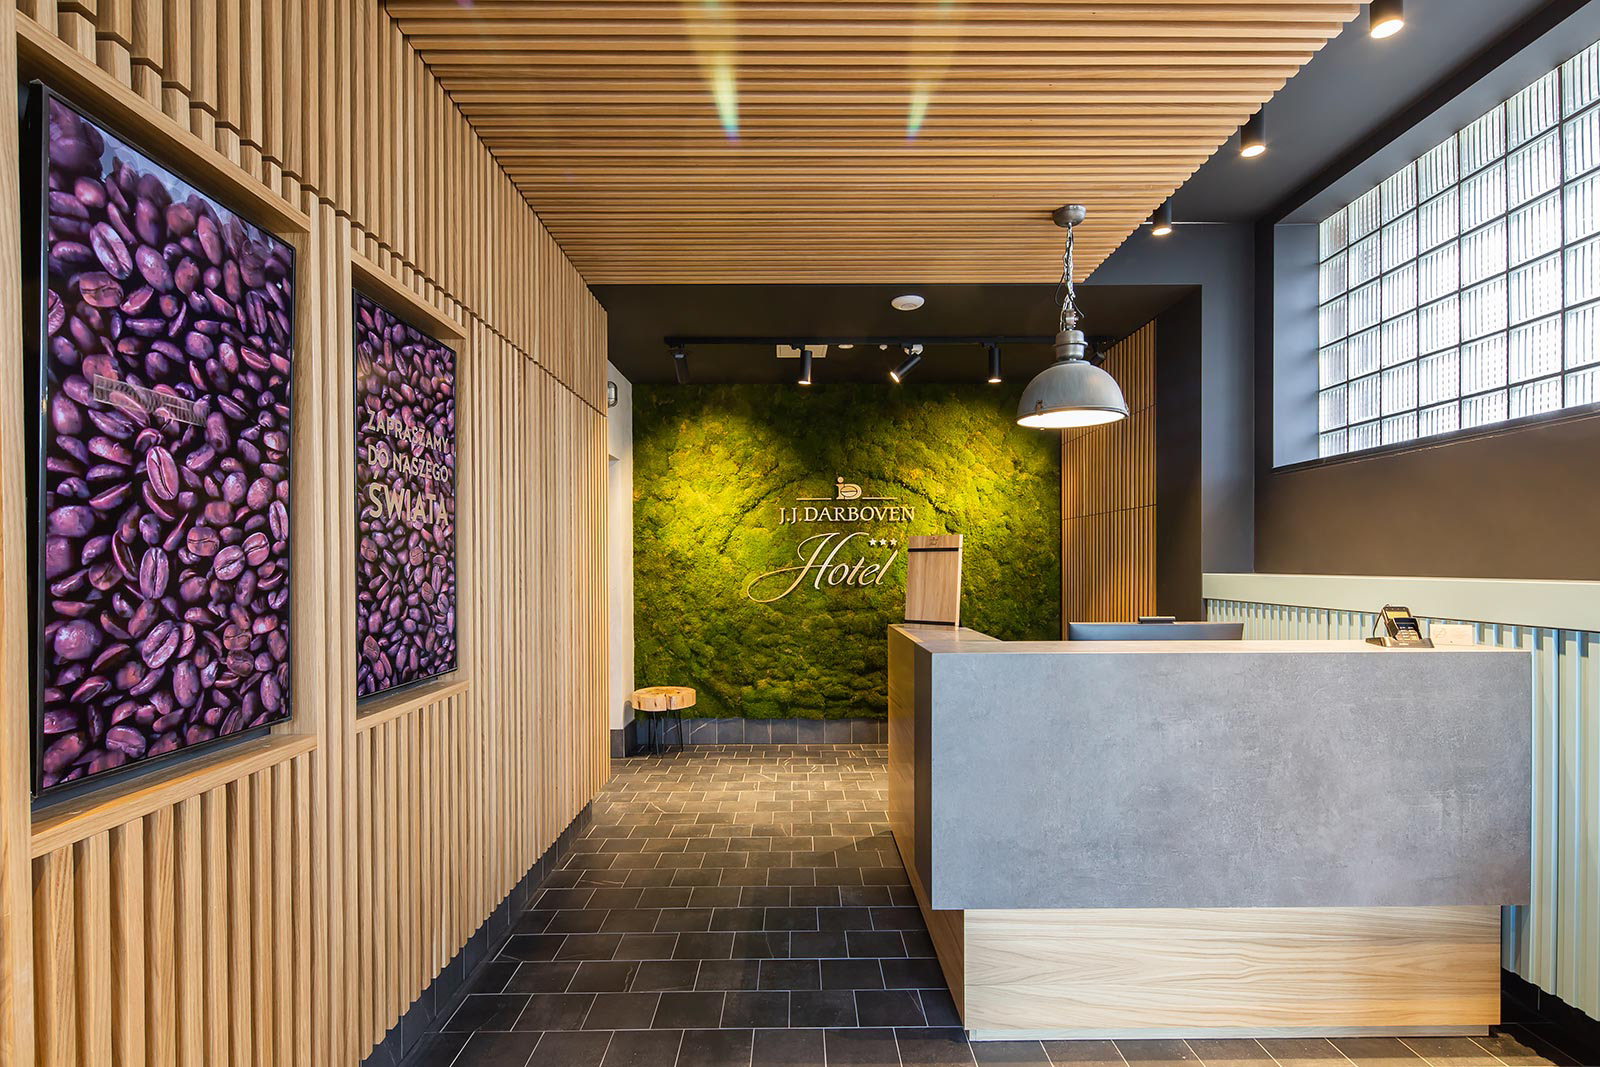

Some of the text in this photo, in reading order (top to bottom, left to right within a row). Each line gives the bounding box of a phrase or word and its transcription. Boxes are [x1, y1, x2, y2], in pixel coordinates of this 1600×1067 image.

[367, 409, 449, 454] ZAPRASZAMY
[367, 444, 449, 483] DO NASZEGO
[368, 470, 449, 526] ŚWIATA
[747, 531, 899, 603] Hotel
